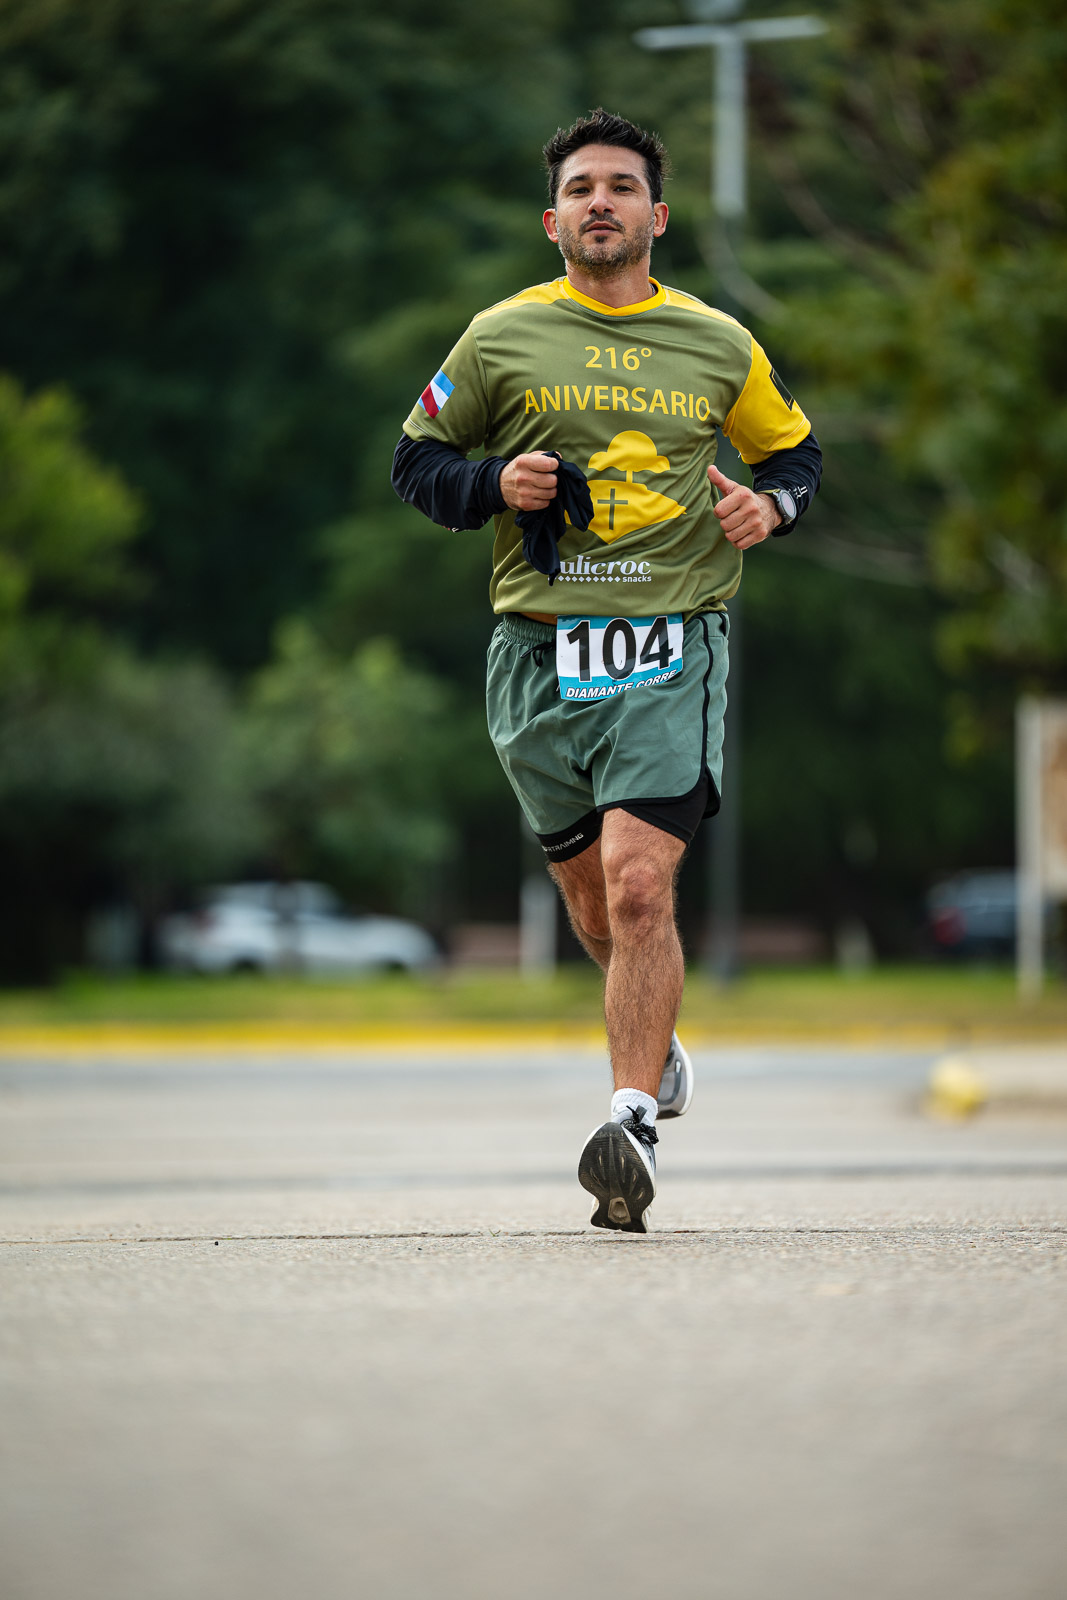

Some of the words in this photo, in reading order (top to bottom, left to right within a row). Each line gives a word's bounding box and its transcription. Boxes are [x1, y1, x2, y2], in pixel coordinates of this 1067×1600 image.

[585, 345, 652, 371] 216°
[525, 385, 711, 422] ANIVERSARIO
[559, 554, 651, 576] ulicroc
[622, 575, 652, 583] snacks
[566, 616, 674, 683] 104
[565, 681, 634, 699] DIAMANTE
[635, 669, 678, 689] CORRE
